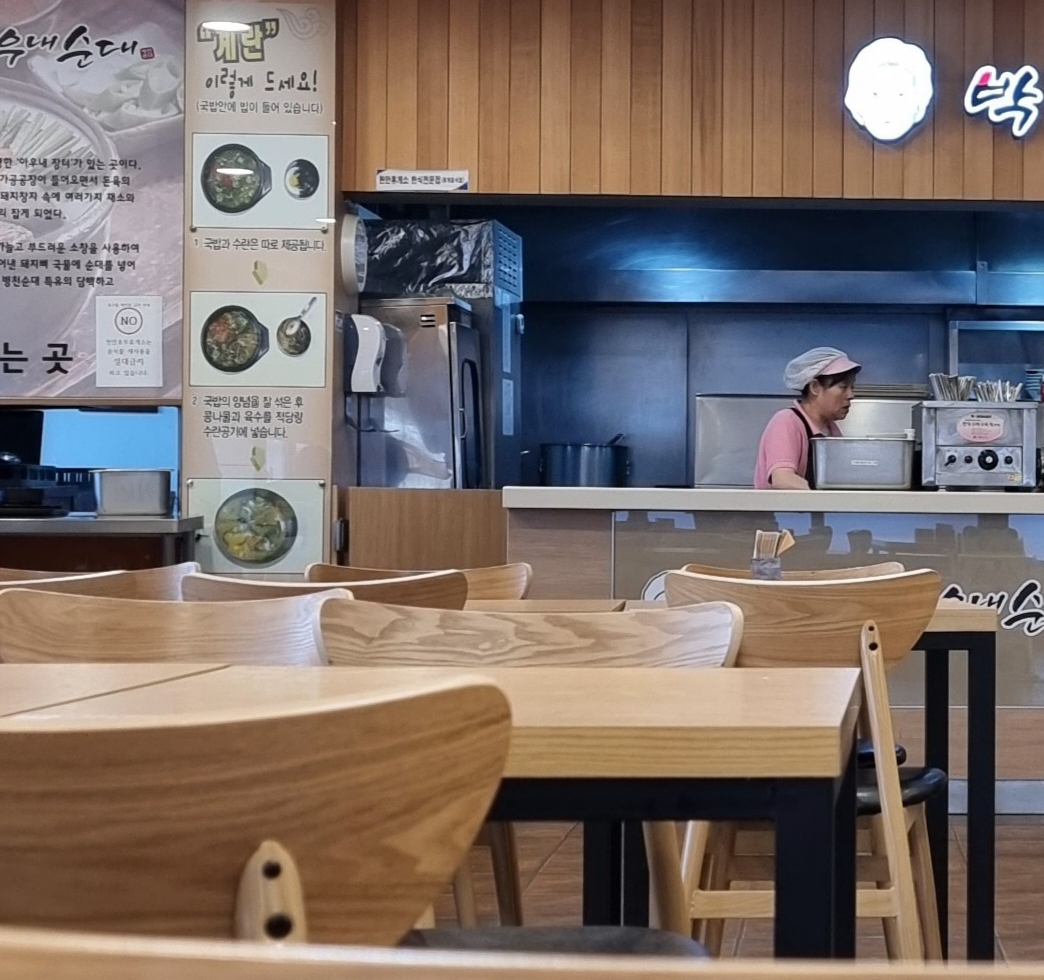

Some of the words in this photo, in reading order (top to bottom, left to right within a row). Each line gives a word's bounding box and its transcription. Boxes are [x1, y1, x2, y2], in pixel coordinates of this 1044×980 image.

[205, 67, 253, 99] 이렇게
[265, 70, 317, 92] 드세요!
[109, 158, 142, 170] 곳이다.
[28, 242, 66, 254] 부드러운
[120, 316, 138, 326] NO
[42, 343, 74, 375] 곳
